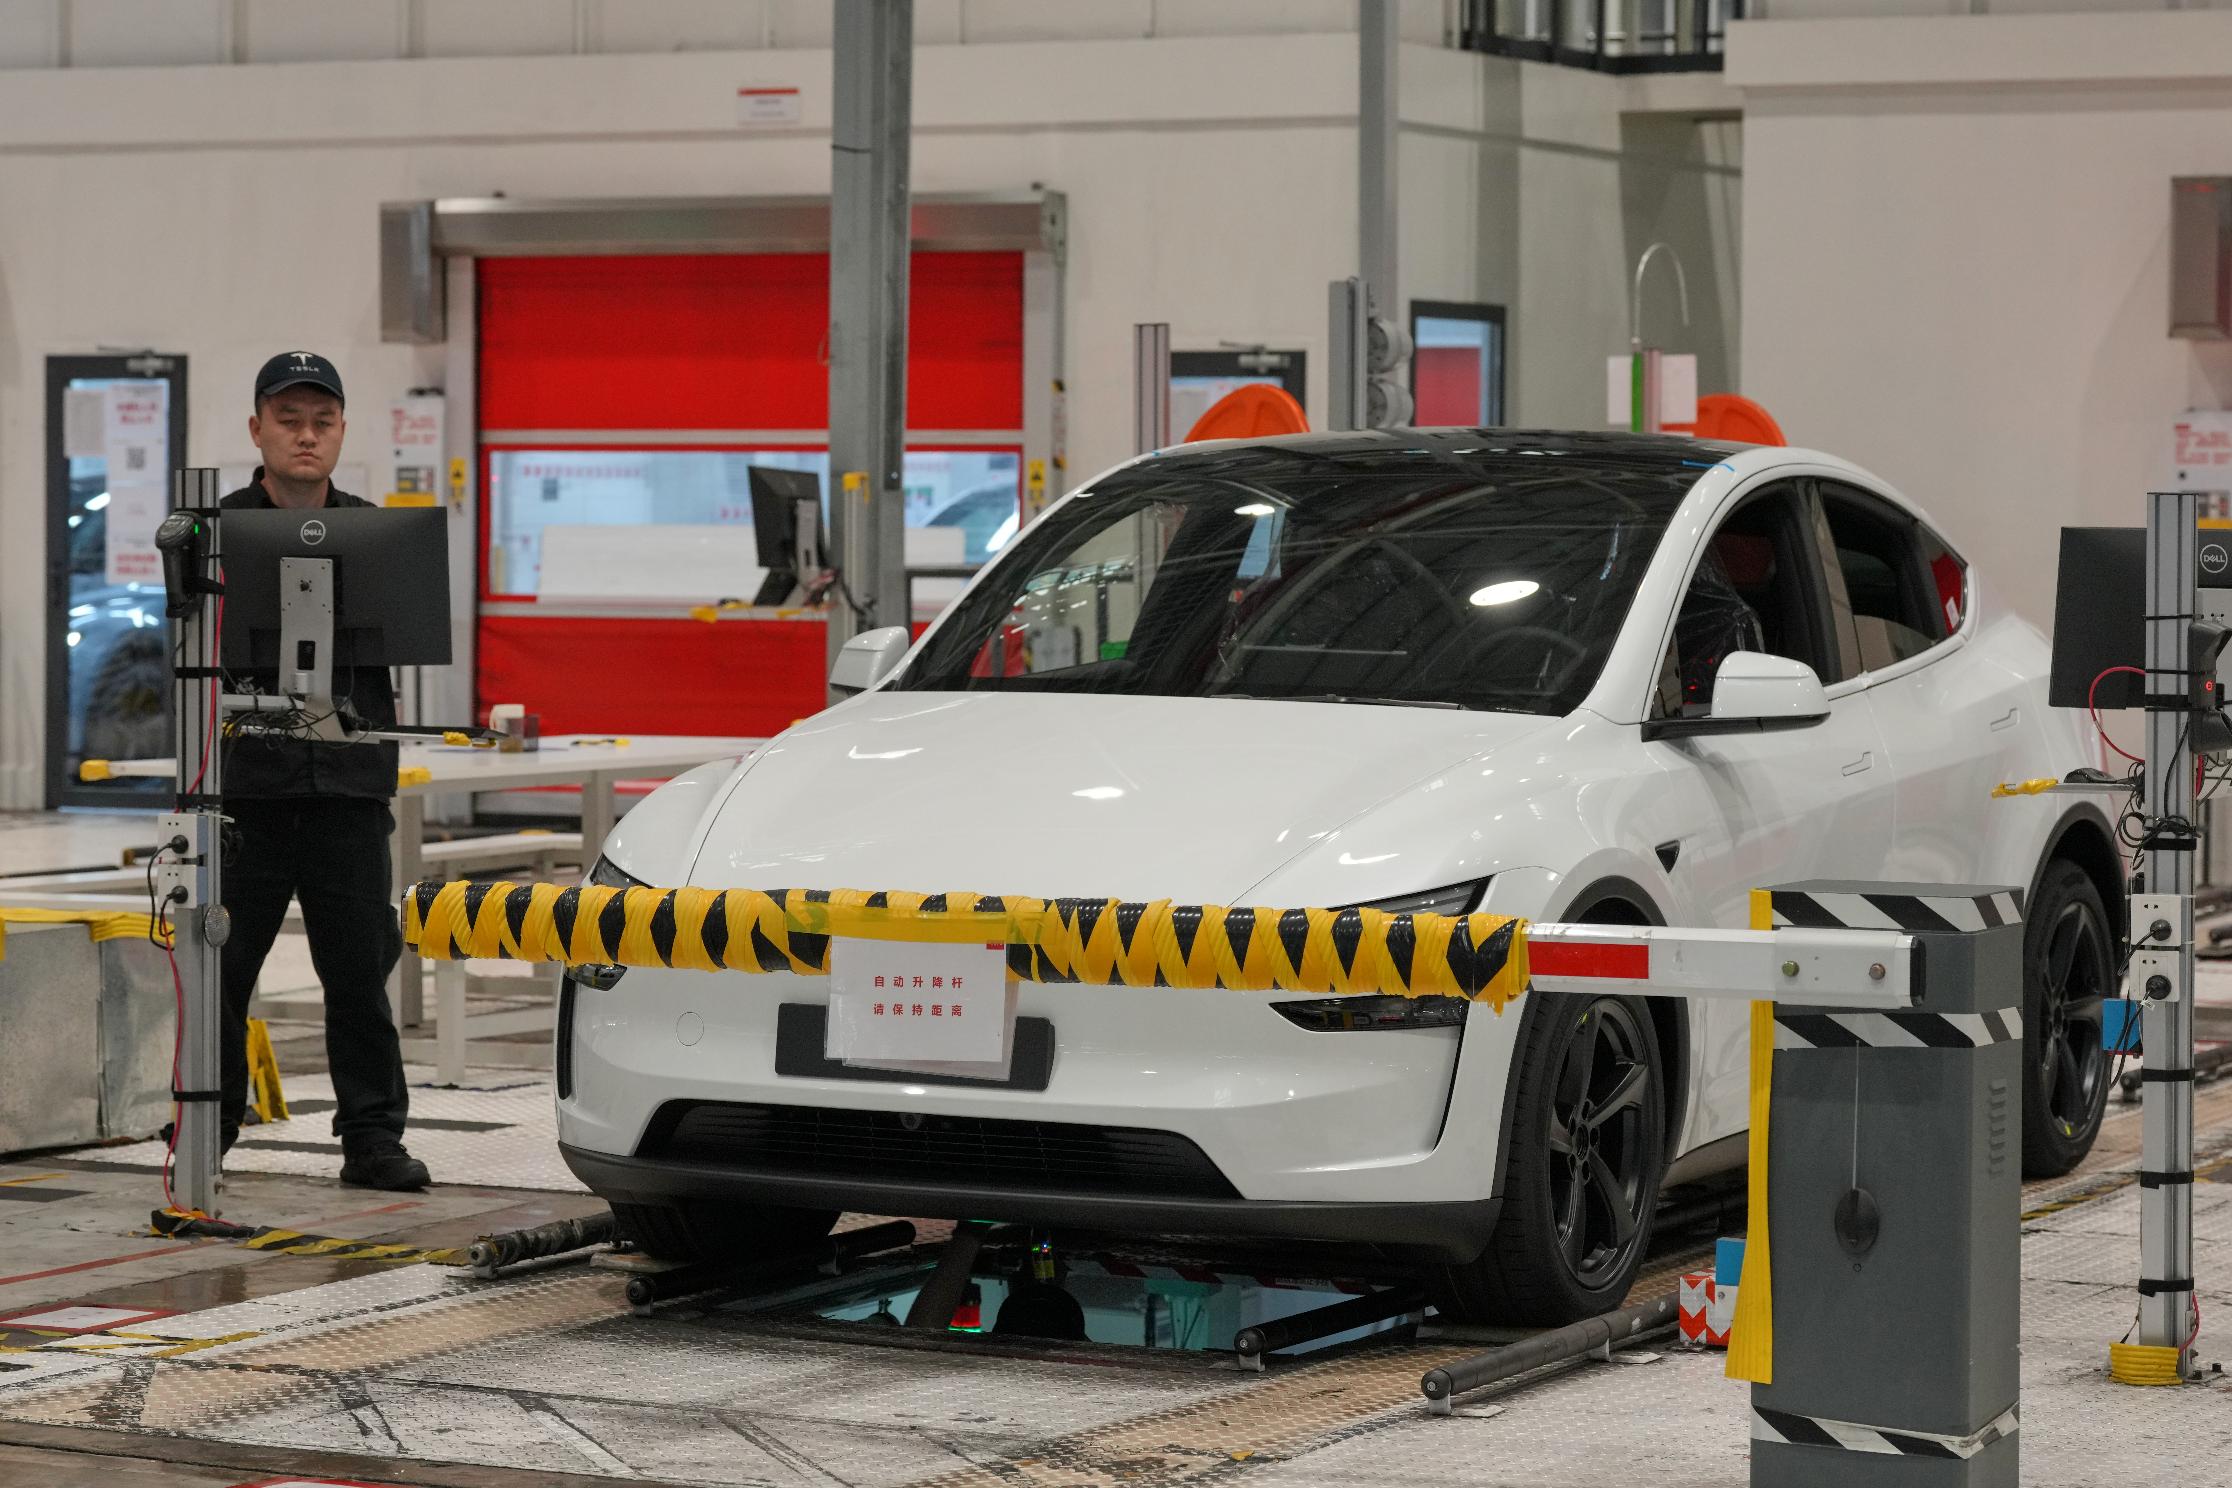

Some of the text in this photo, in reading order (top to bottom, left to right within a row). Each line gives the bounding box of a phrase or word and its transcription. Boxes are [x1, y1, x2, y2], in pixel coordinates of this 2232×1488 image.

[2203, 554, 2226, 563] DELL
[874, 976, 963, 989] 自动升降杆
[873, 1003, 963, 1017] 请保持距离
